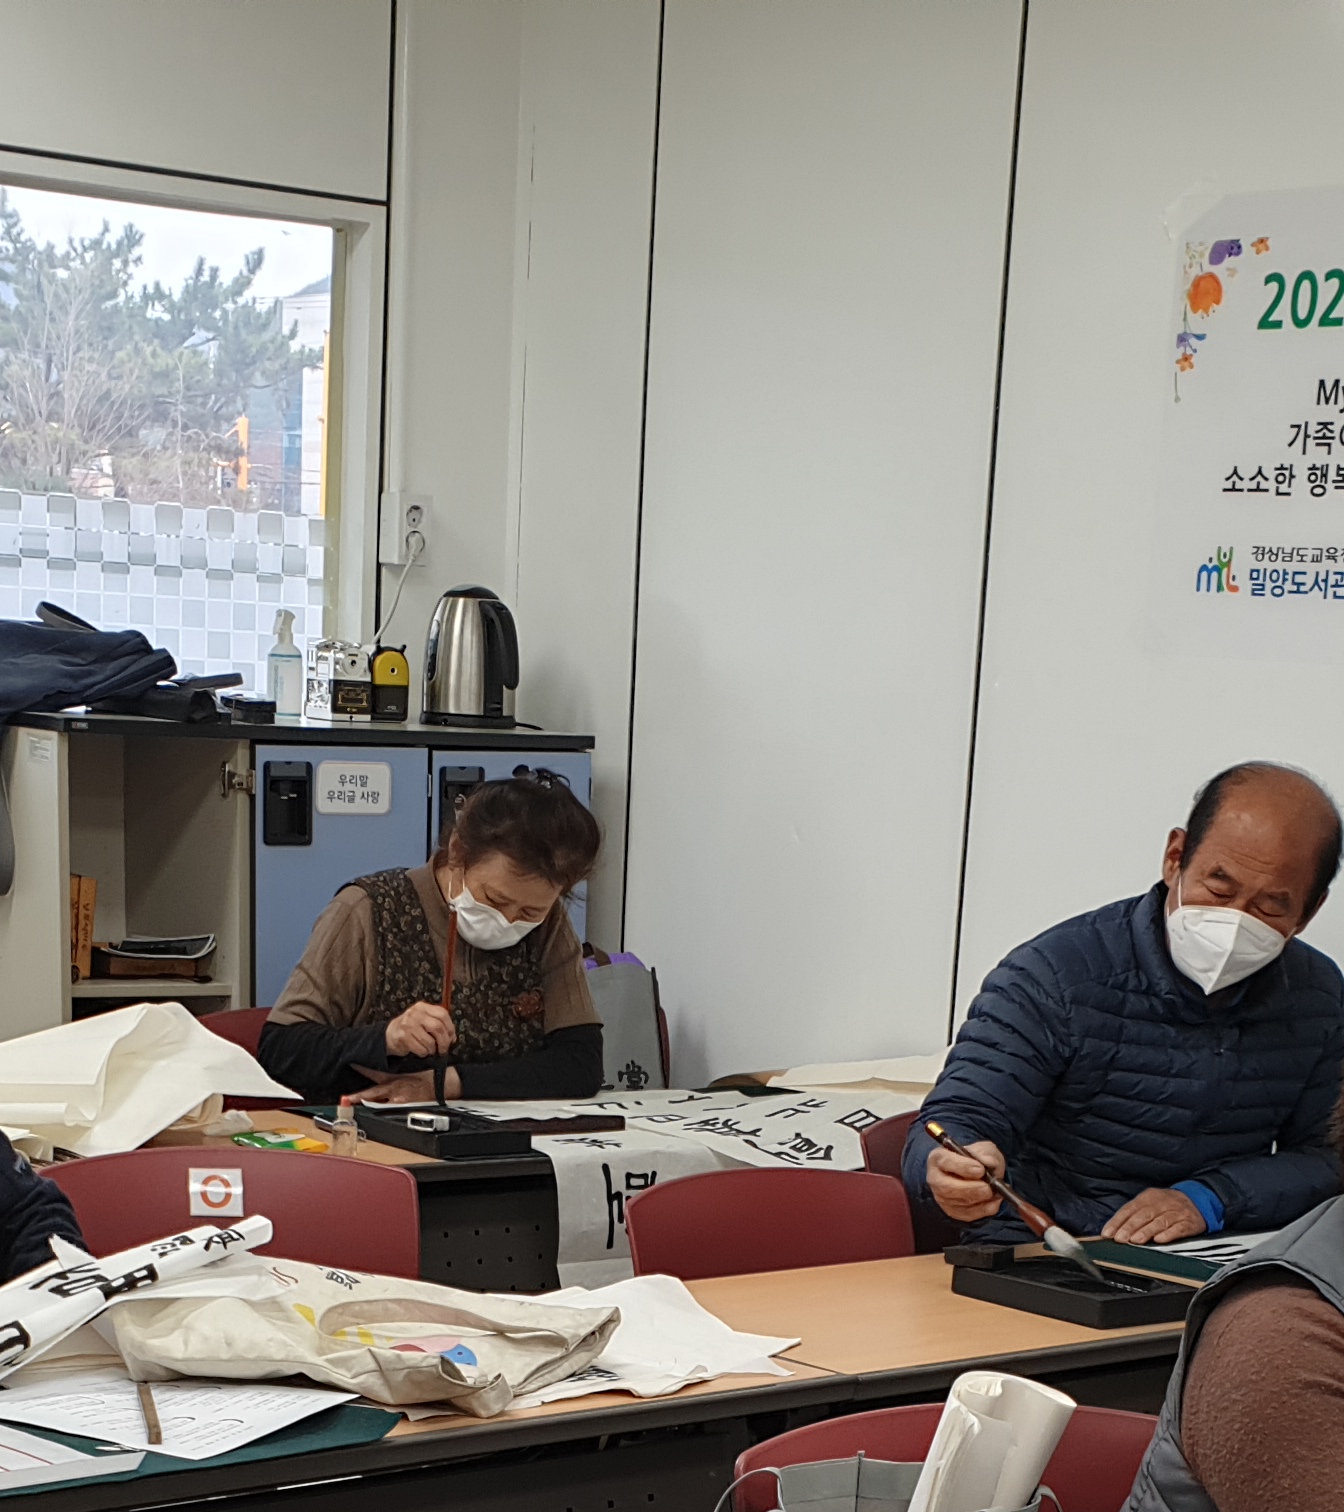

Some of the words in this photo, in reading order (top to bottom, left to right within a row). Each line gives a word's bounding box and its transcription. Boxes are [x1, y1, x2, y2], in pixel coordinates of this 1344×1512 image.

[1222, 463, 1297, 497] 소소한
[338, 774, 369, 788] 우리말
[326, 789, 356, 804] 우리글
[359, 790, 380, 805] 사랑
